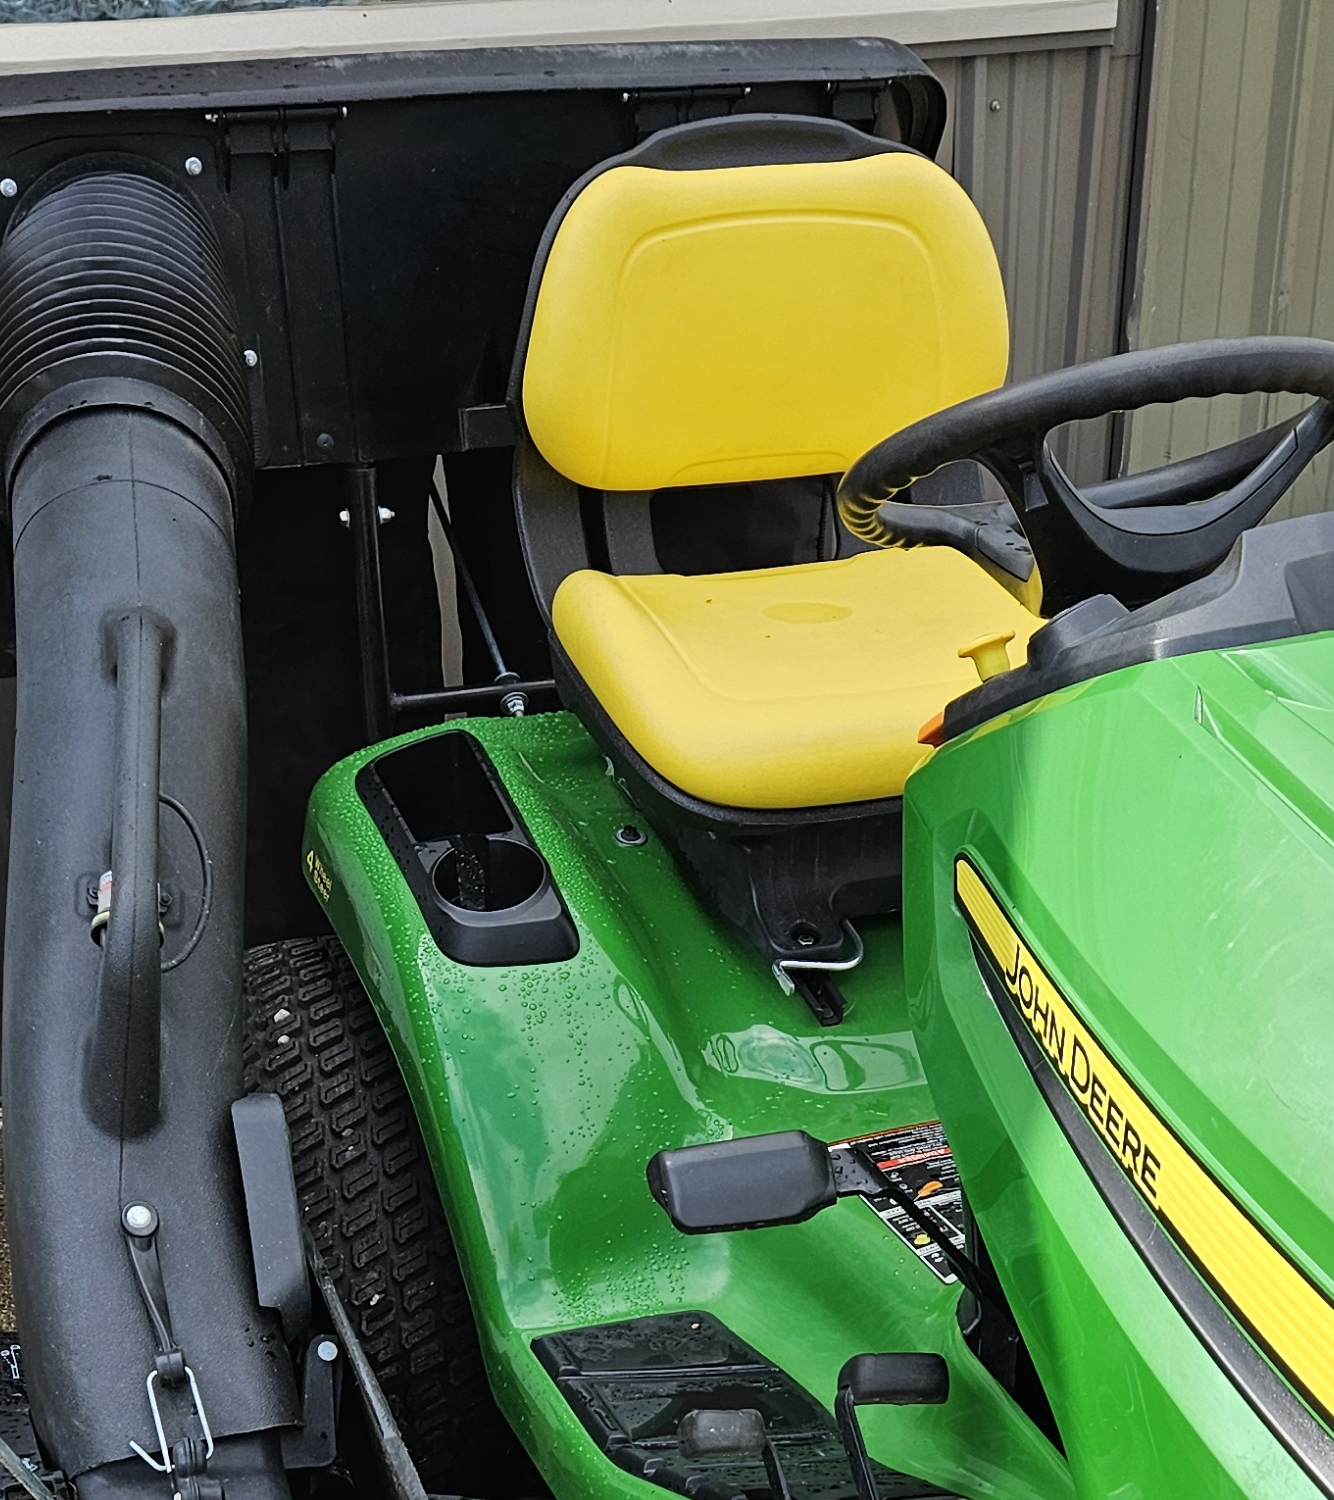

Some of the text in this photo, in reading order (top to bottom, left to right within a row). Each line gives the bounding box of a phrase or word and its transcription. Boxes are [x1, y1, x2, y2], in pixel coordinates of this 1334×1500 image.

[306, 849, 314, 873] 4
[1005, 943, 1162, 1199] JOHN DEERE
